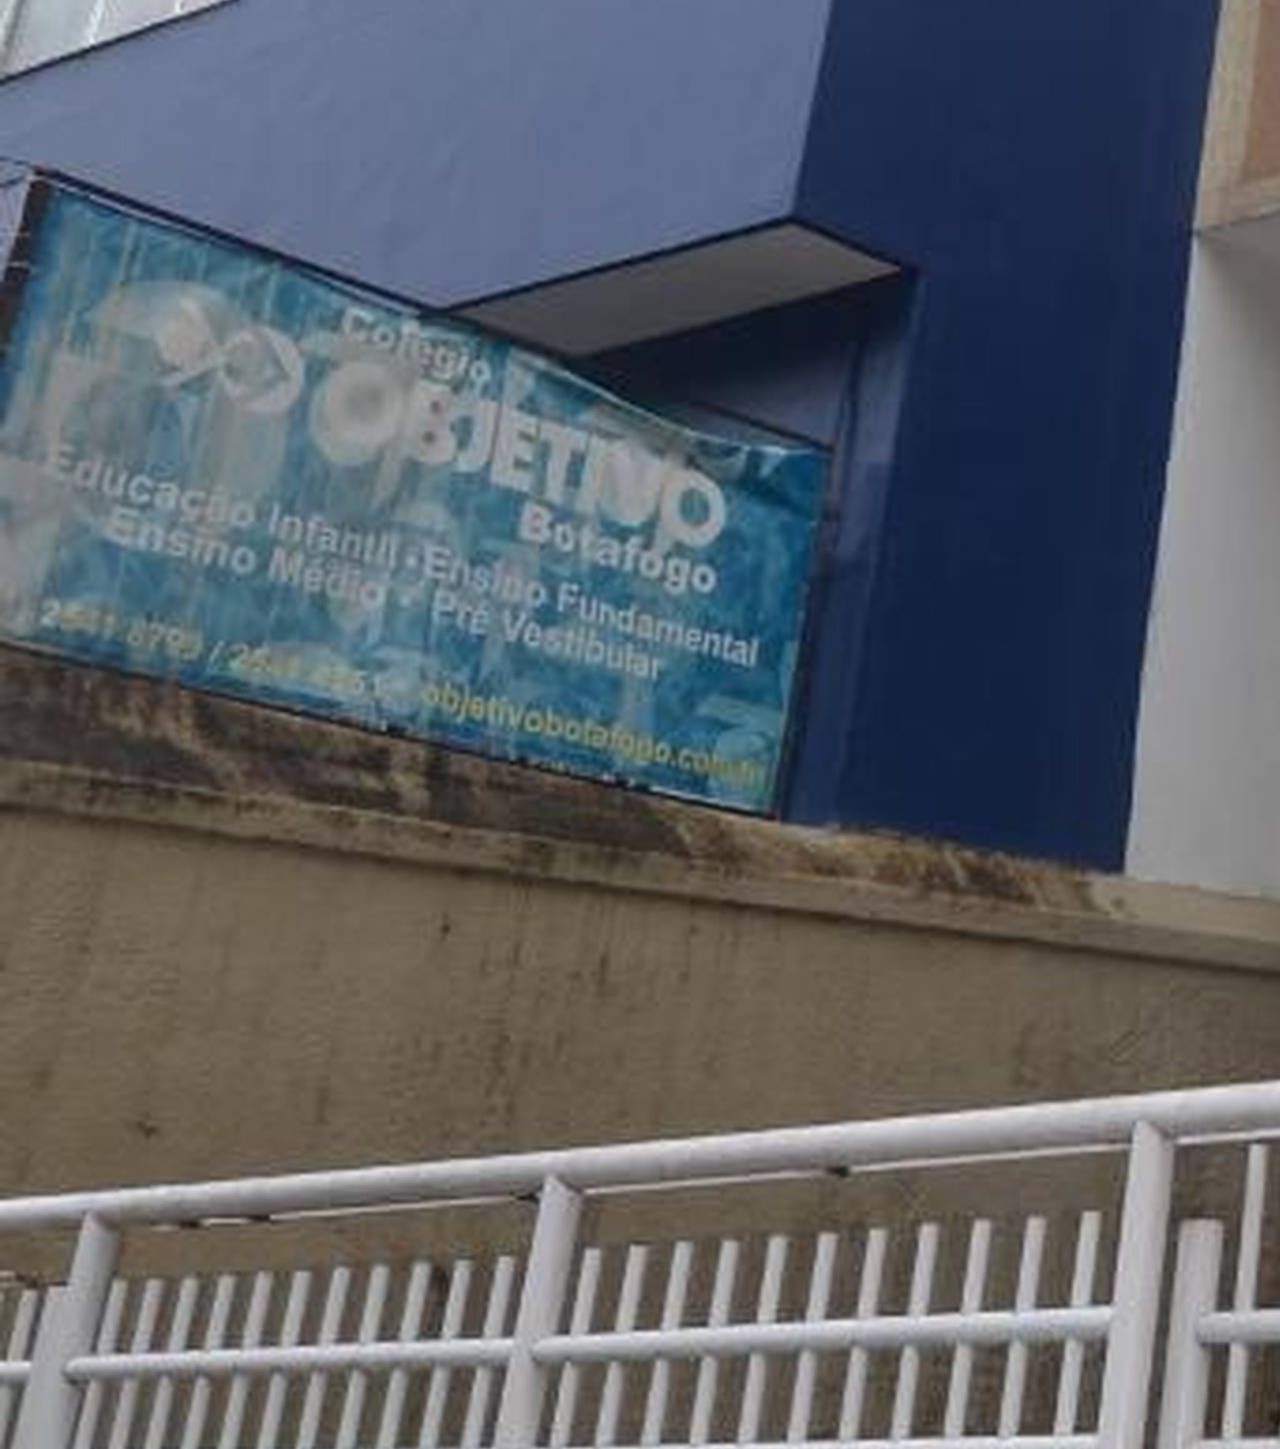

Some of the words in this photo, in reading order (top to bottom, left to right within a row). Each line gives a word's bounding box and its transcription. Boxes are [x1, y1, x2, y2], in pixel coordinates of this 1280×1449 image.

[103, 507, 257, 575] Ensino
[268, 545, 386, 609] Médio
[431, 589, 489, 636] Pré
[503, 609, 662, 681] Vestibular
[268, 502, 400, 569] Infantil
[422, 545, 547, 608] Ensino
[556, 581, 760, 668] Fundamental
[516, 501, 718, 595] Botafogo
